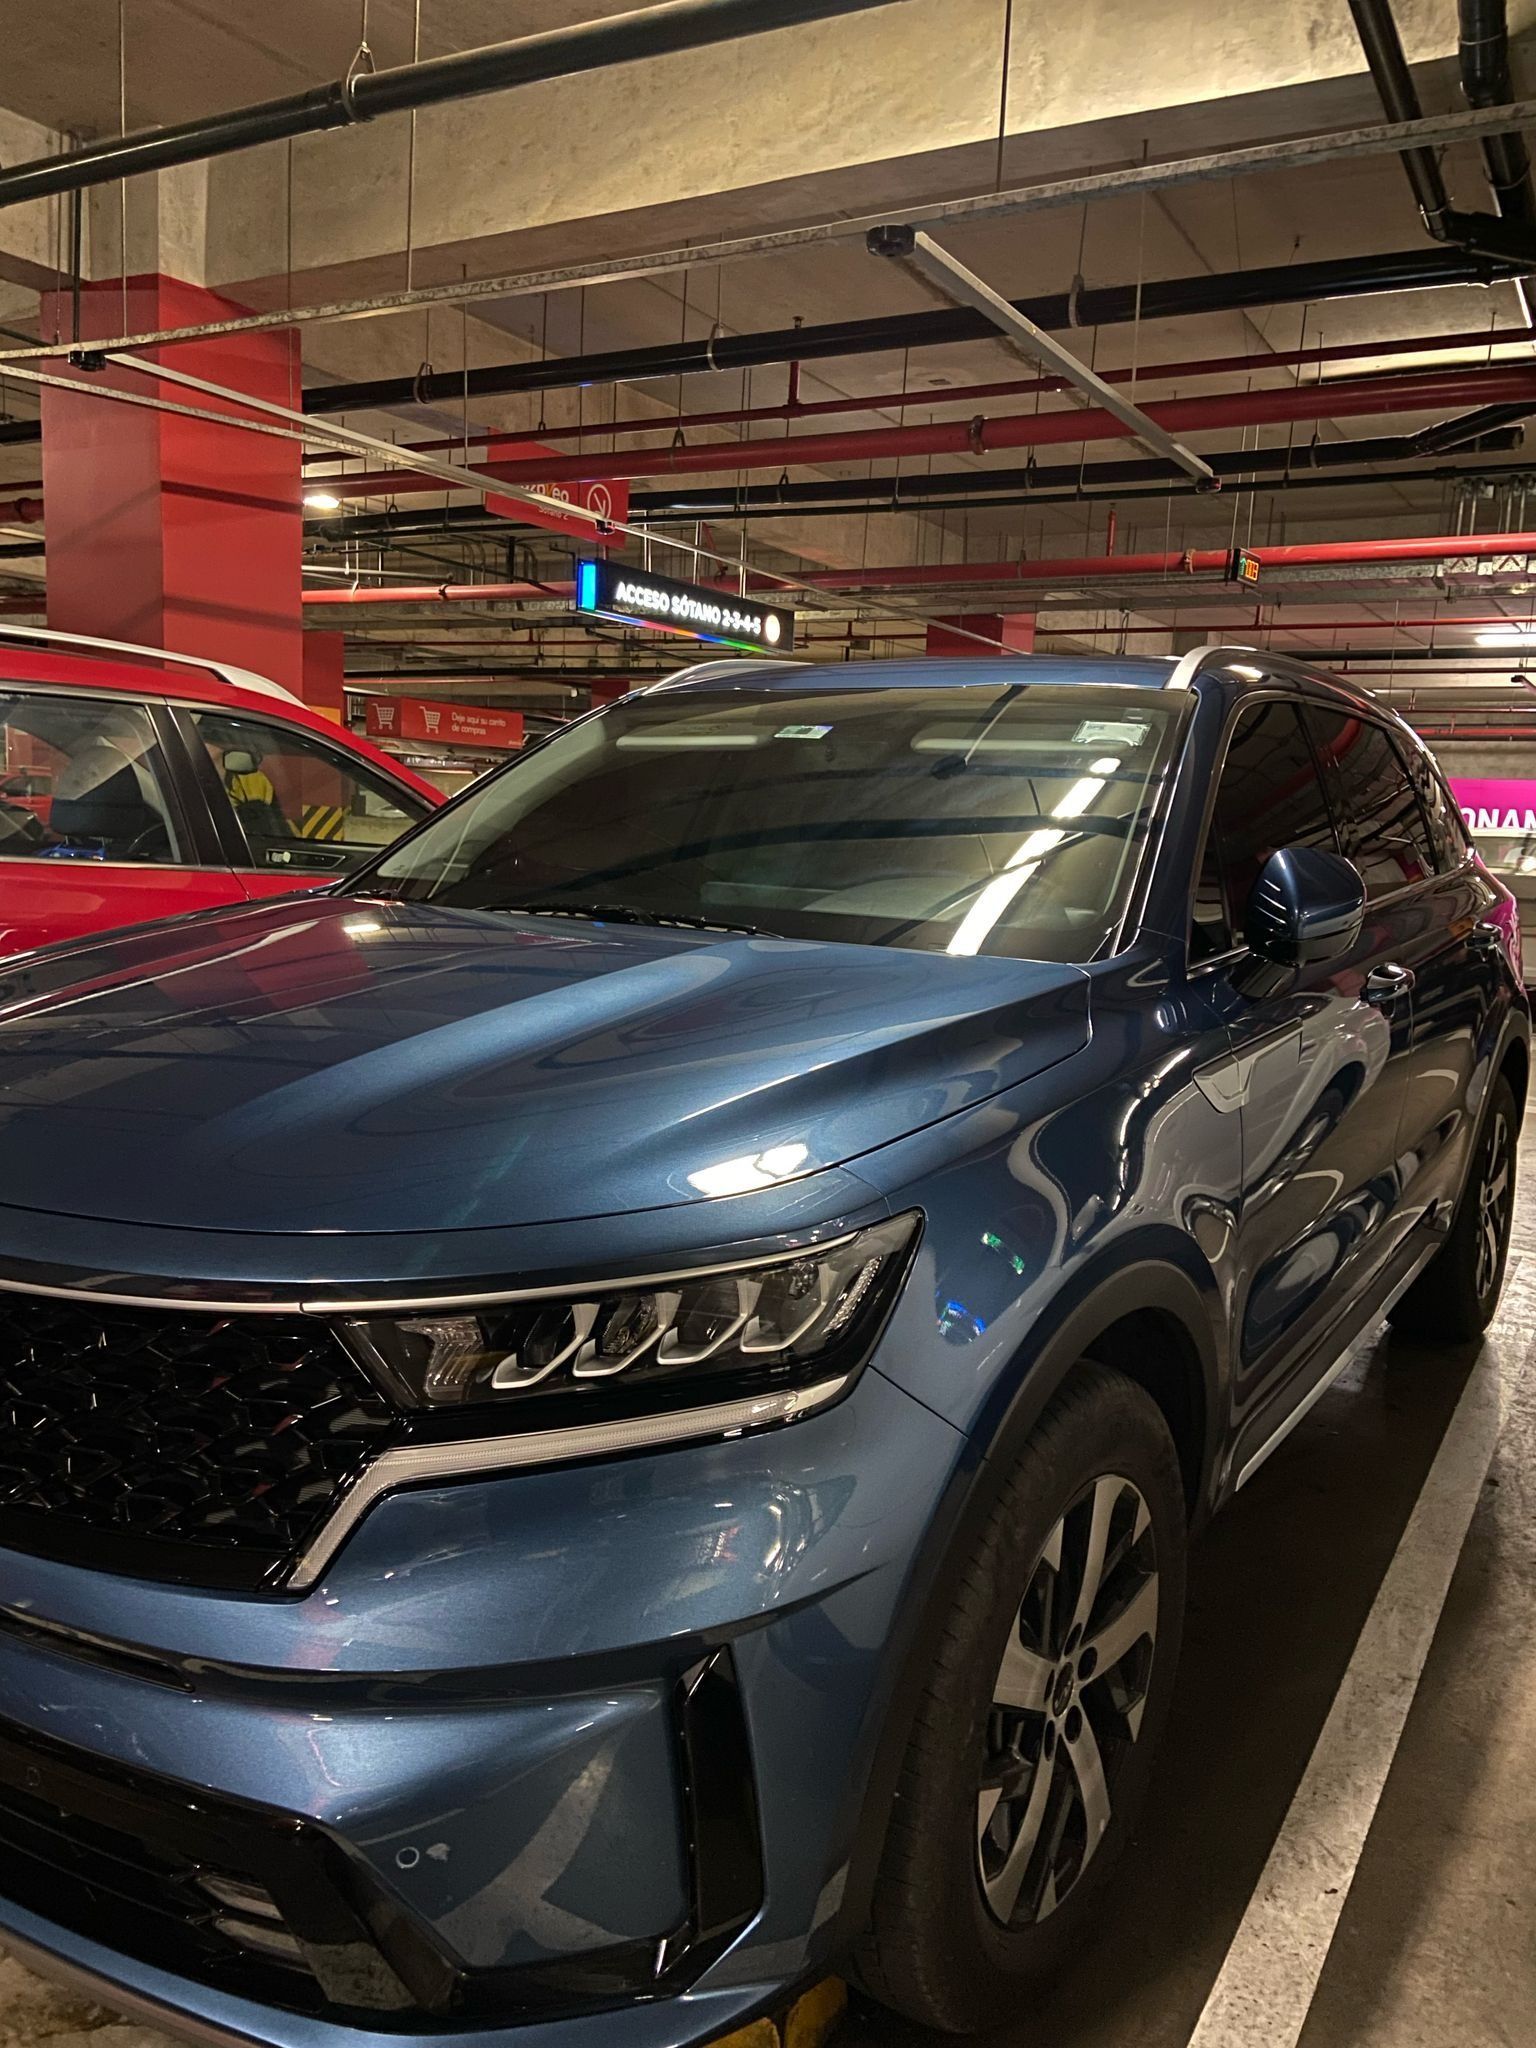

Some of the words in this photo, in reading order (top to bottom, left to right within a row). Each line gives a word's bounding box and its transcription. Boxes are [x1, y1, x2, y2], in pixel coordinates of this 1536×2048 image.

[616, 582, 670, 611] ACCESO
[671, 594, 722, 624] SÓTANO
[722, 609, 762, 635] 2-3-4-5
[452, 712, 465, 723] Deje
[452, 724, 459, 732] de
[461, 725, 487, 736] compras
